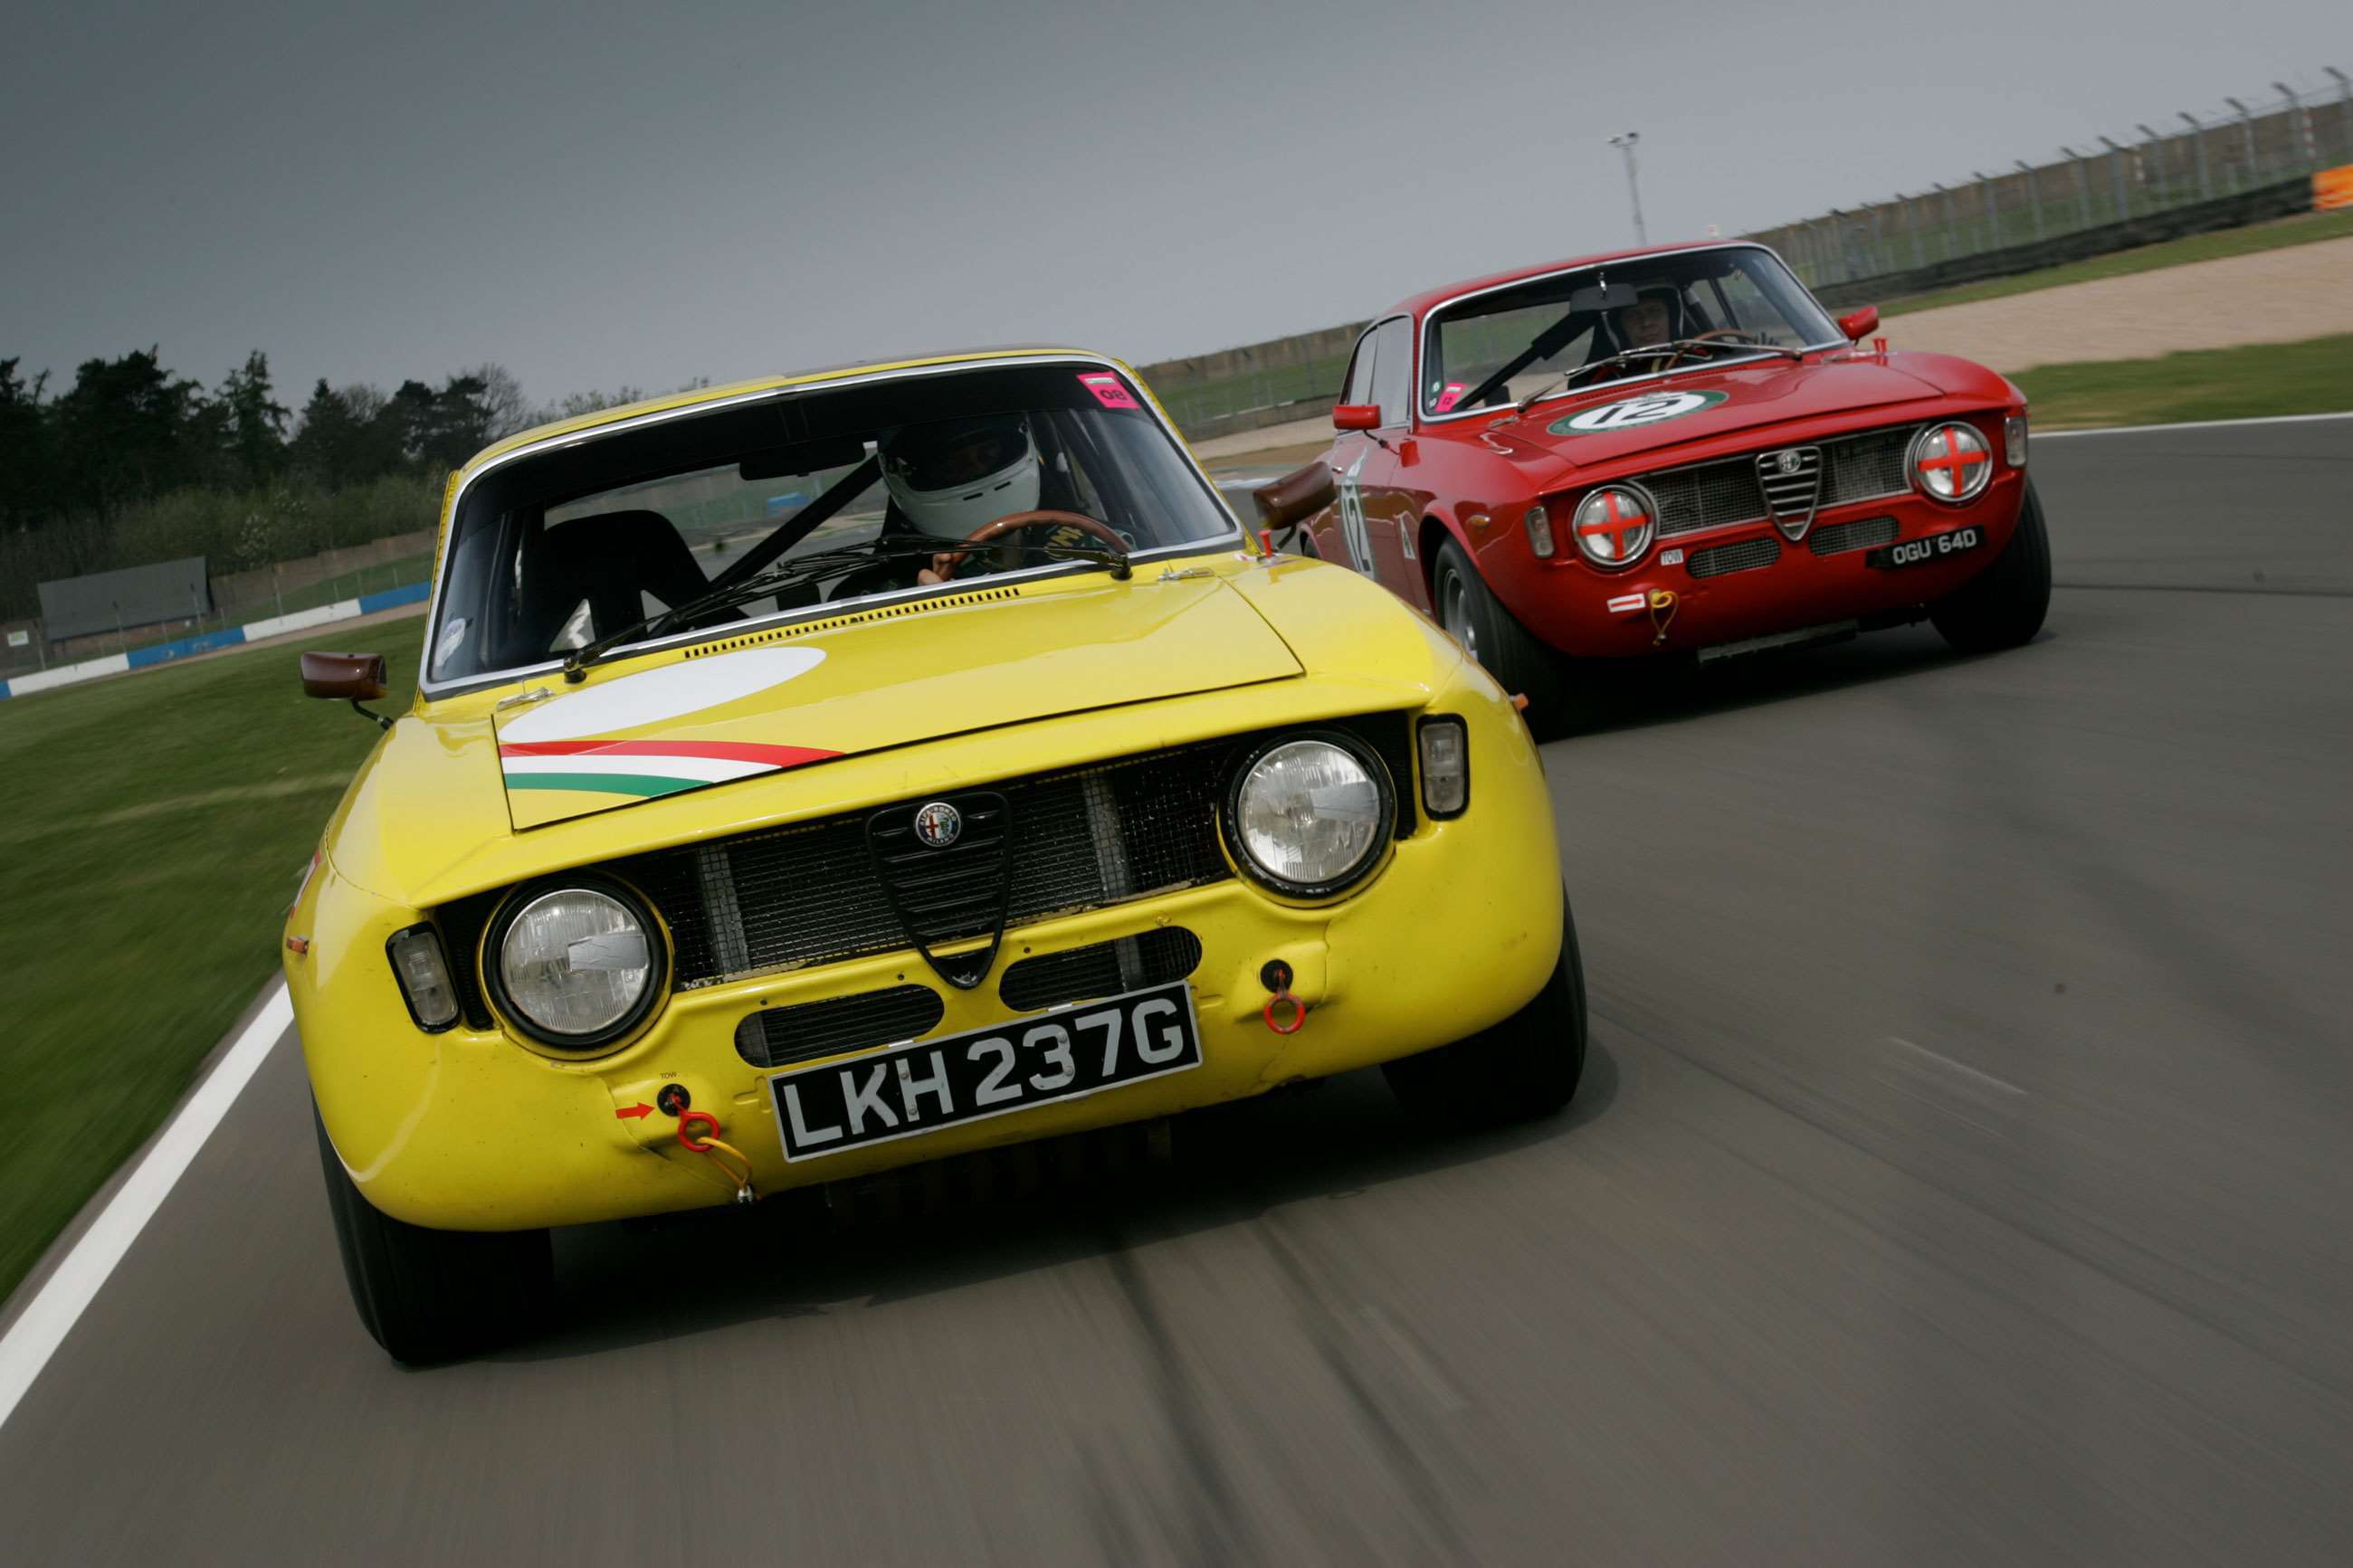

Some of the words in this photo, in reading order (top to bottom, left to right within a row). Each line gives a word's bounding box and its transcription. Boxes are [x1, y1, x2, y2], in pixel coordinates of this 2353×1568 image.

[1593, 399, 1682, 425] 12
[1662, 550, 1681, 565] TOW
[1892, 539, 1931, 565] OGU
[1938, 528, 1977, 554] 64D
[659, 1071, 679, 1079] TOW
[783, 1050, 954, 1148] LKH
[966, 998, 1185, 1107] 237G
